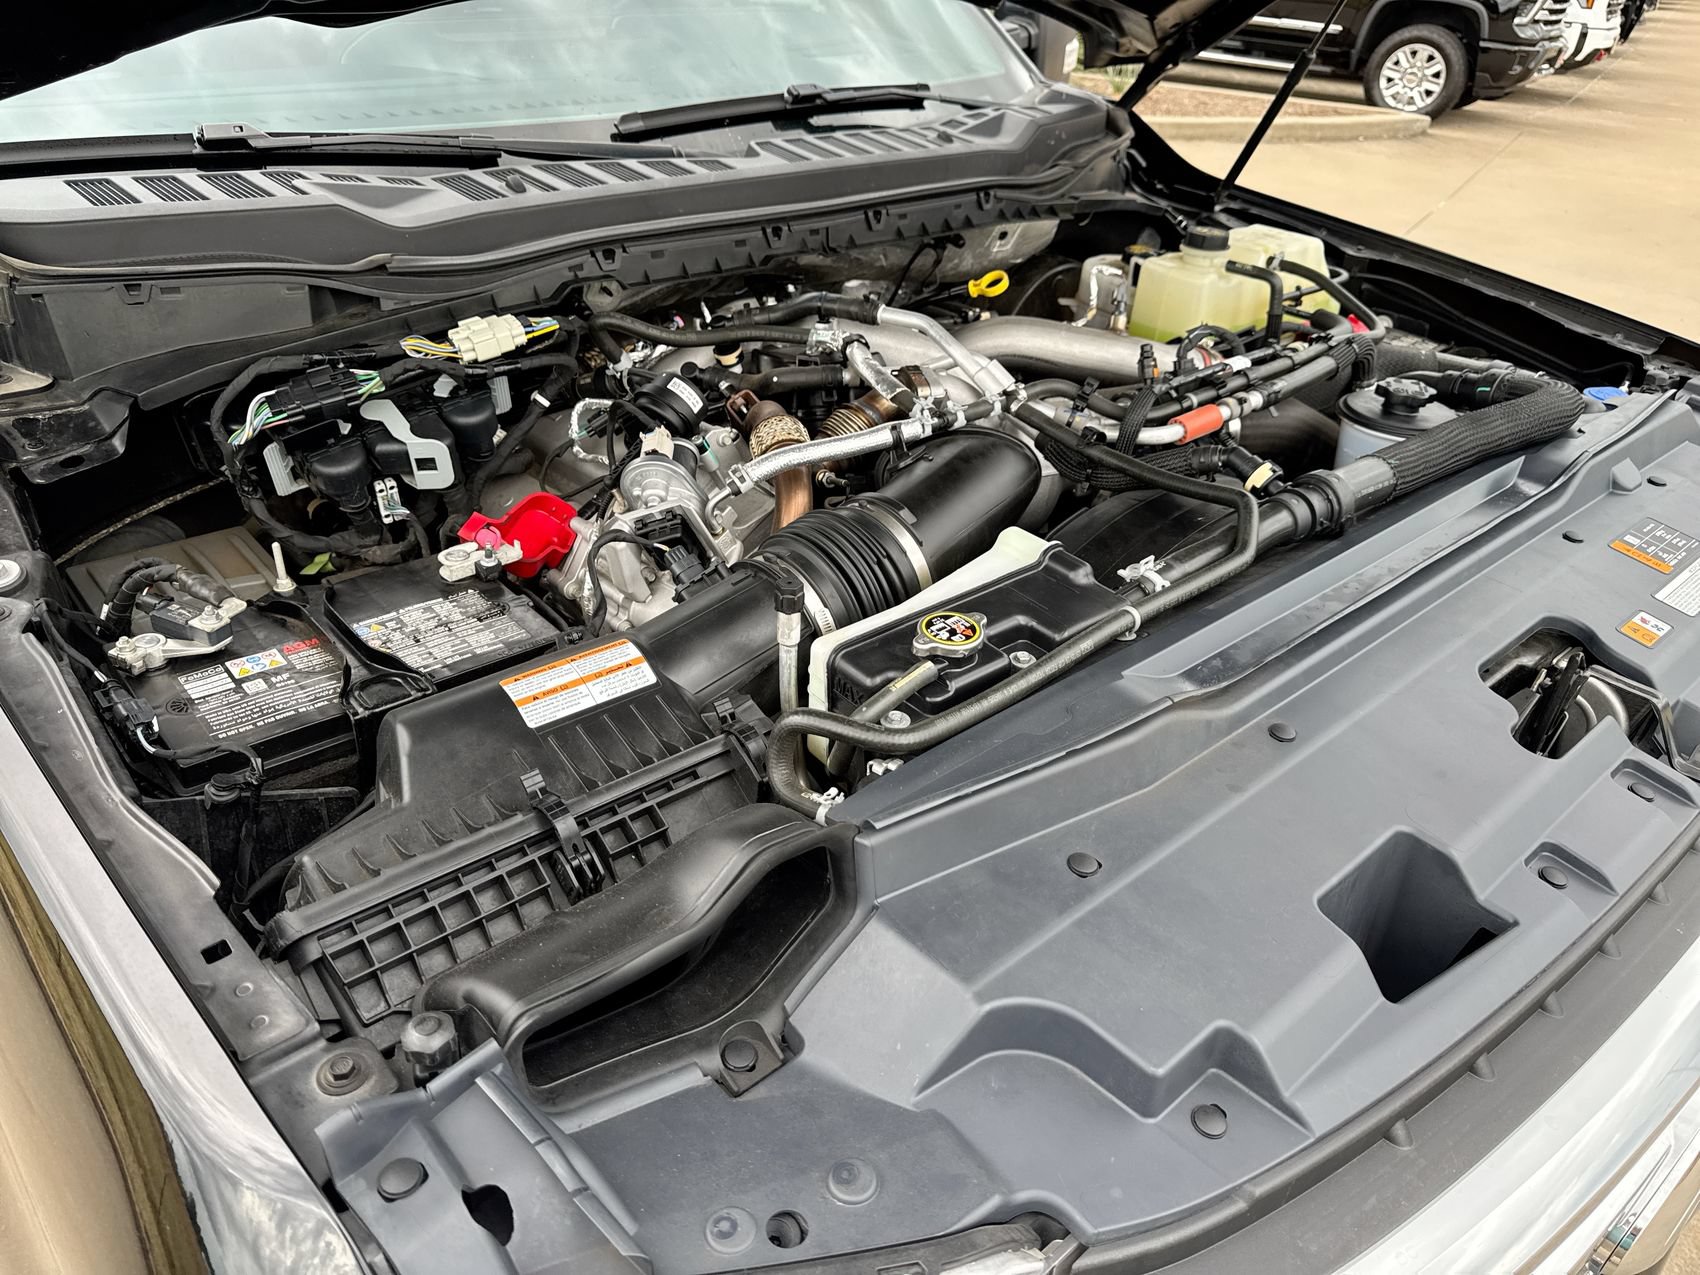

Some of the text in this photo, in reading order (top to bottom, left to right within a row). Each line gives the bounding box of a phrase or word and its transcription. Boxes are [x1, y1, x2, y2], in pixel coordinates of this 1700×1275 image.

[282, 637, 320, 655] AGM
[181, 667, 222, 683] FoMoCo
[270, 672, 290, 684] MF
[834, 677, 864, 705] MAX
